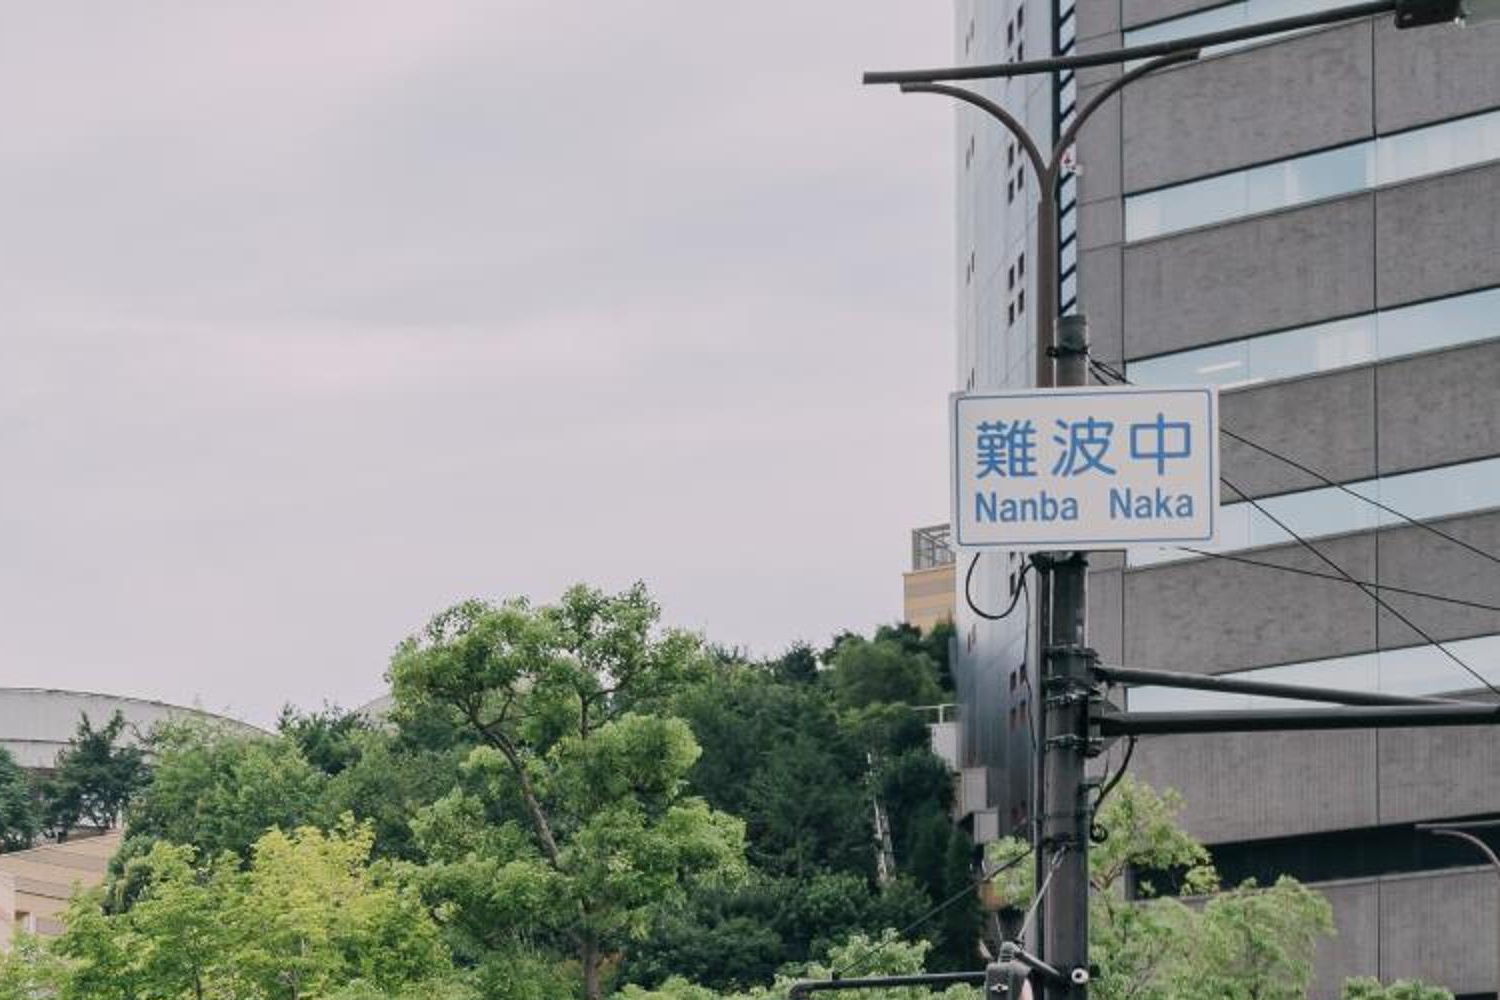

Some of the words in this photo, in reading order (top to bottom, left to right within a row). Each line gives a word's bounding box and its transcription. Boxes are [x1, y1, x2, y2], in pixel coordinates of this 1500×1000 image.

[976, 412, 1192, 479] 難波中
[975, 489, 1079, 523] Nanba
[1109, 486, 1194, 519] Naka
